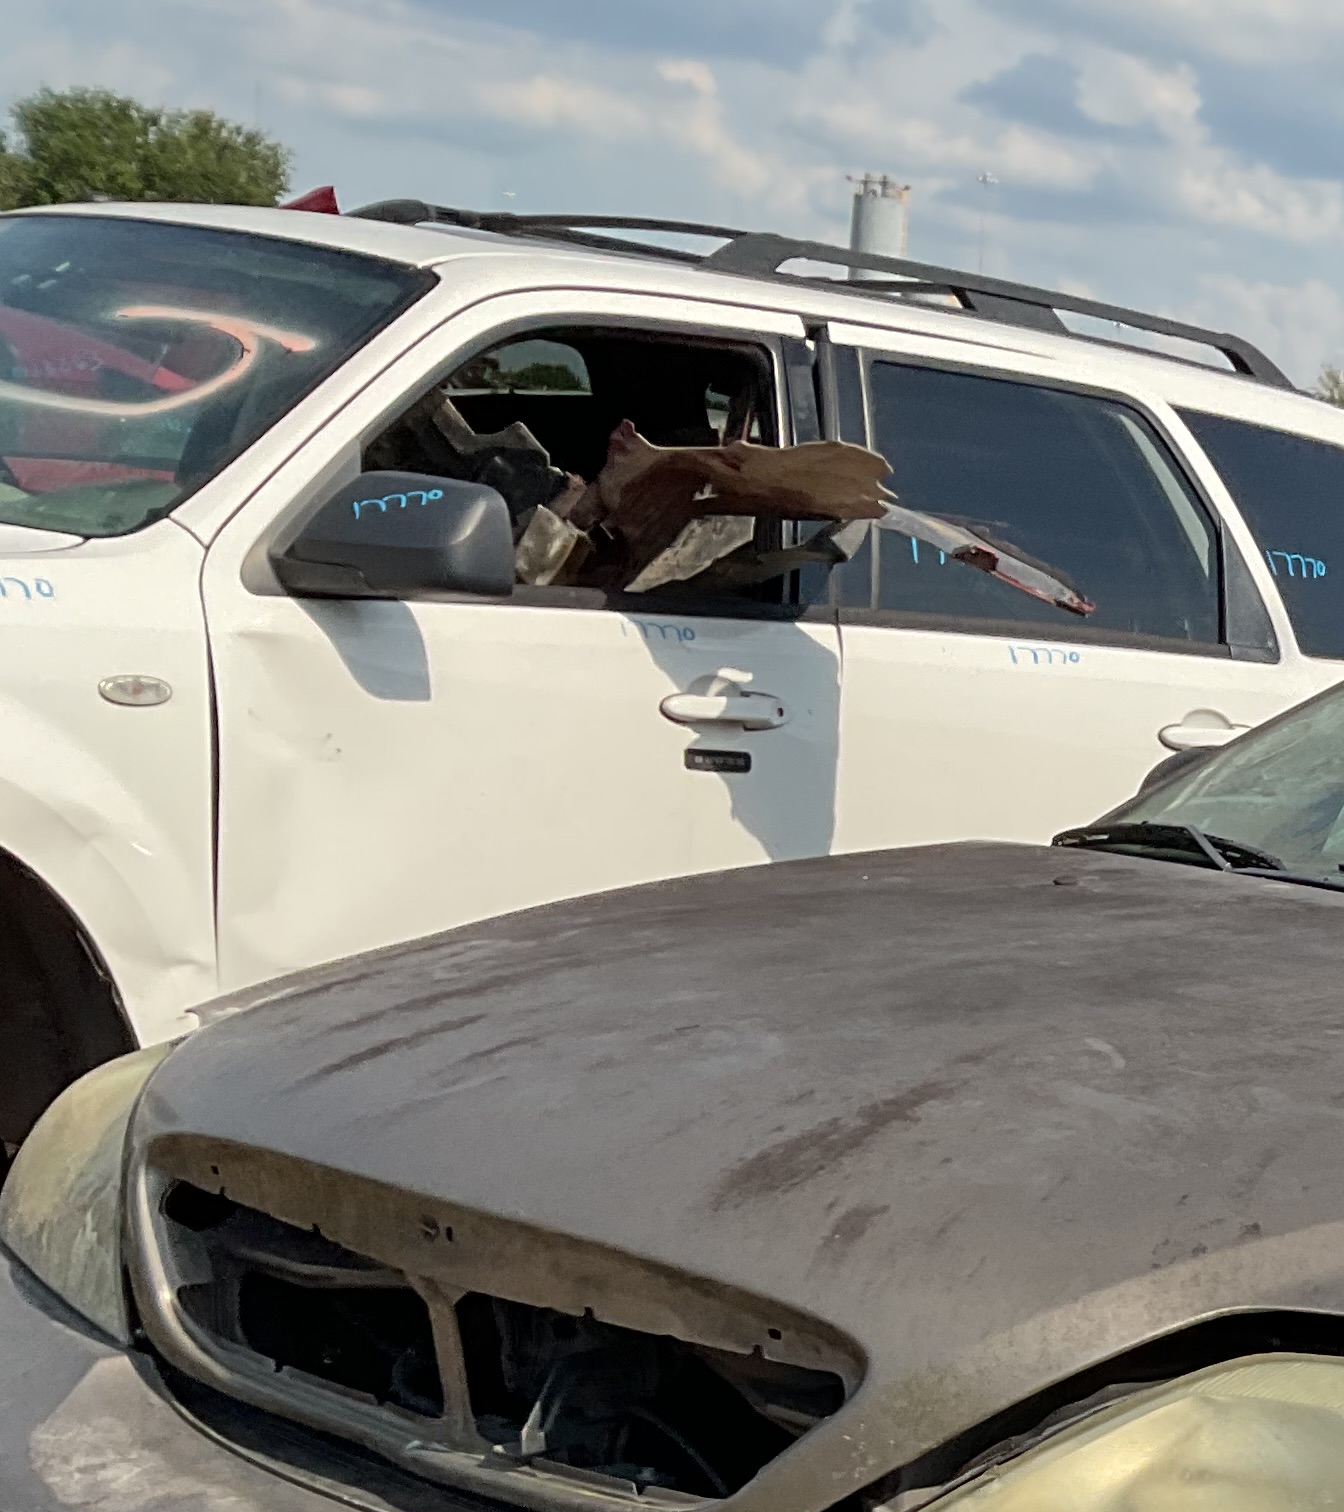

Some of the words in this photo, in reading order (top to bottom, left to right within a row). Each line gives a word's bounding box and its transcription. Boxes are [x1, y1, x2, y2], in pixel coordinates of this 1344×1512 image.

[352, 489, 443, 520] 17770
[1265, 549, 1326, 578] 17770
[620, 619, 695, 642] 17770
[1008, 645, 1079, 664] 17770
